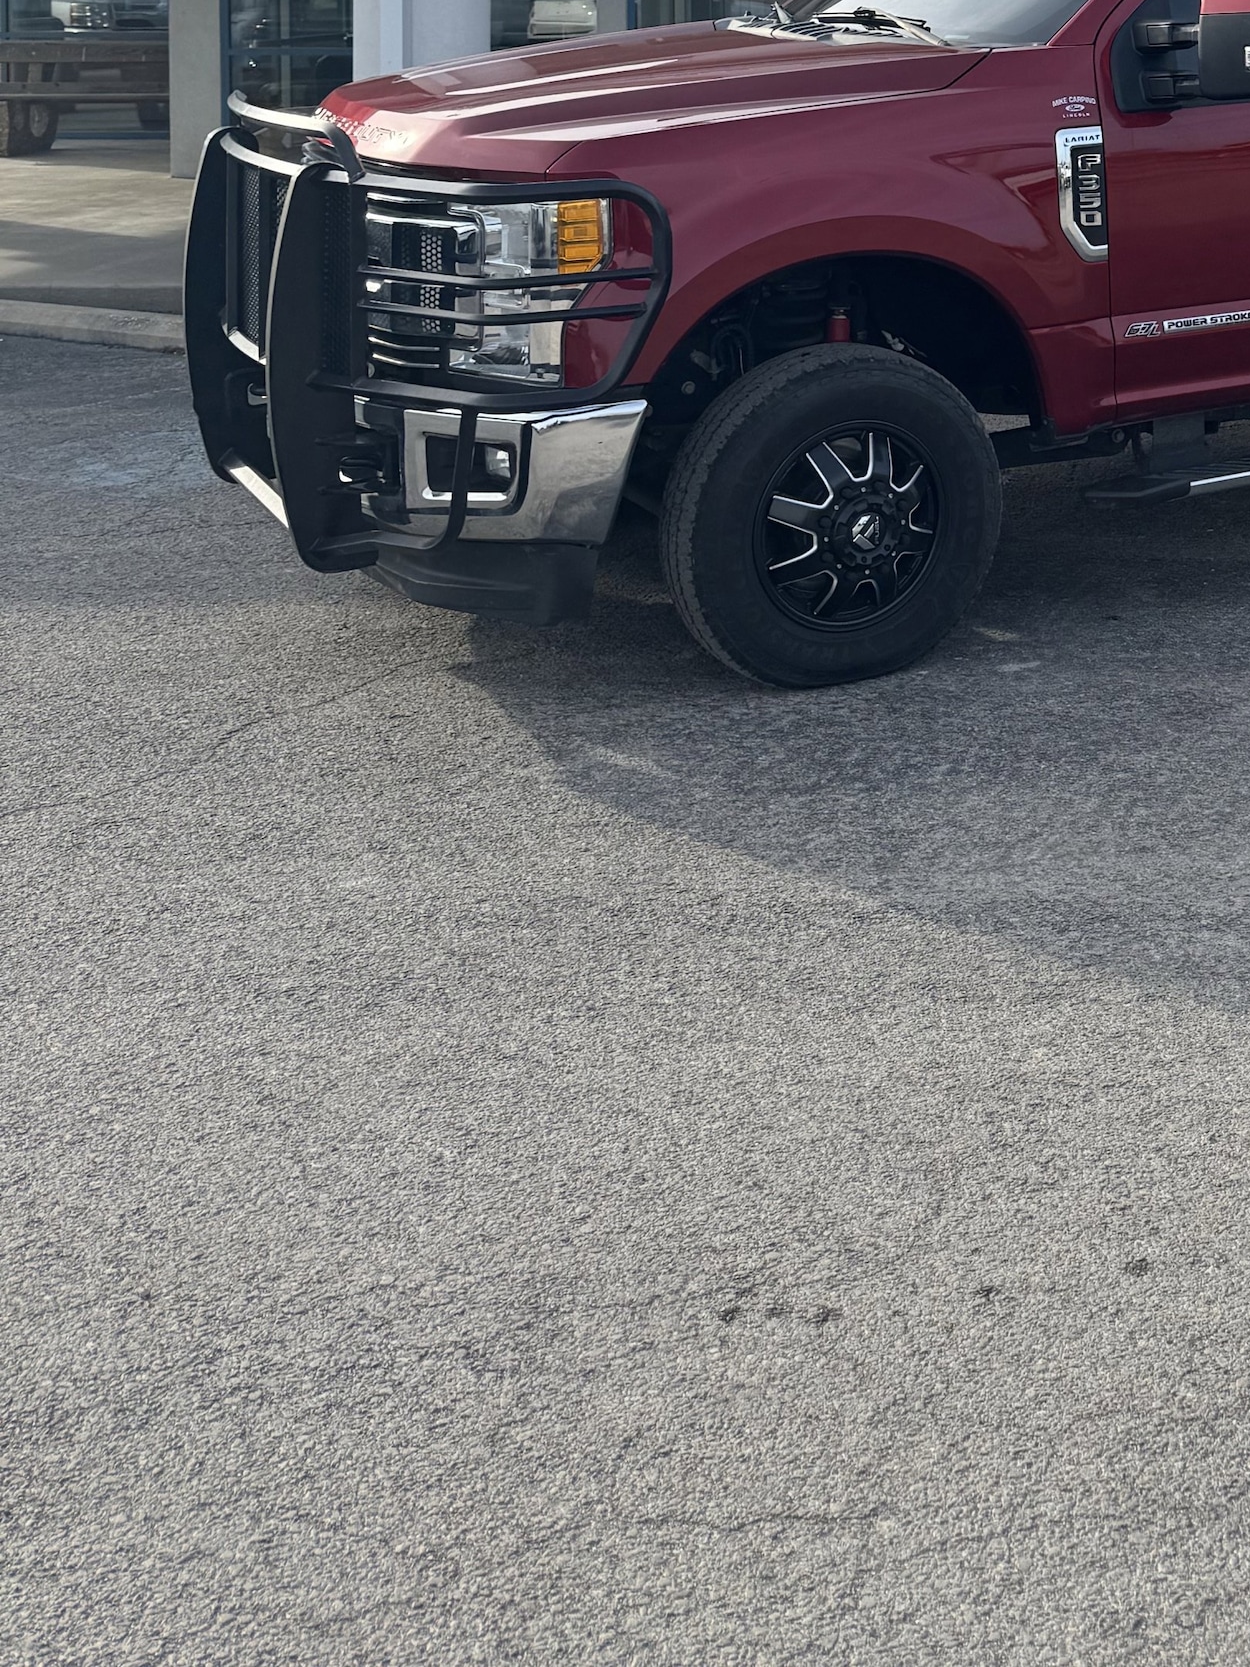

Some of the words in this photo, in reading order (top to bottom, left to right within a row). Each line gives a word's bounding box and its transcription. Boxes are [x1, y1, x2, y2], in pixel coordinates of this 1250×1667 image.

[1052, 97, 1068, 107] MIKE
[1068, 96, 1097, 105] CARPINO
[1065, 134, 1101, 143] LARIAT
[1124, 321, 1161, 338] 6.7L
[1166, 318, 1208, 330] POWER
